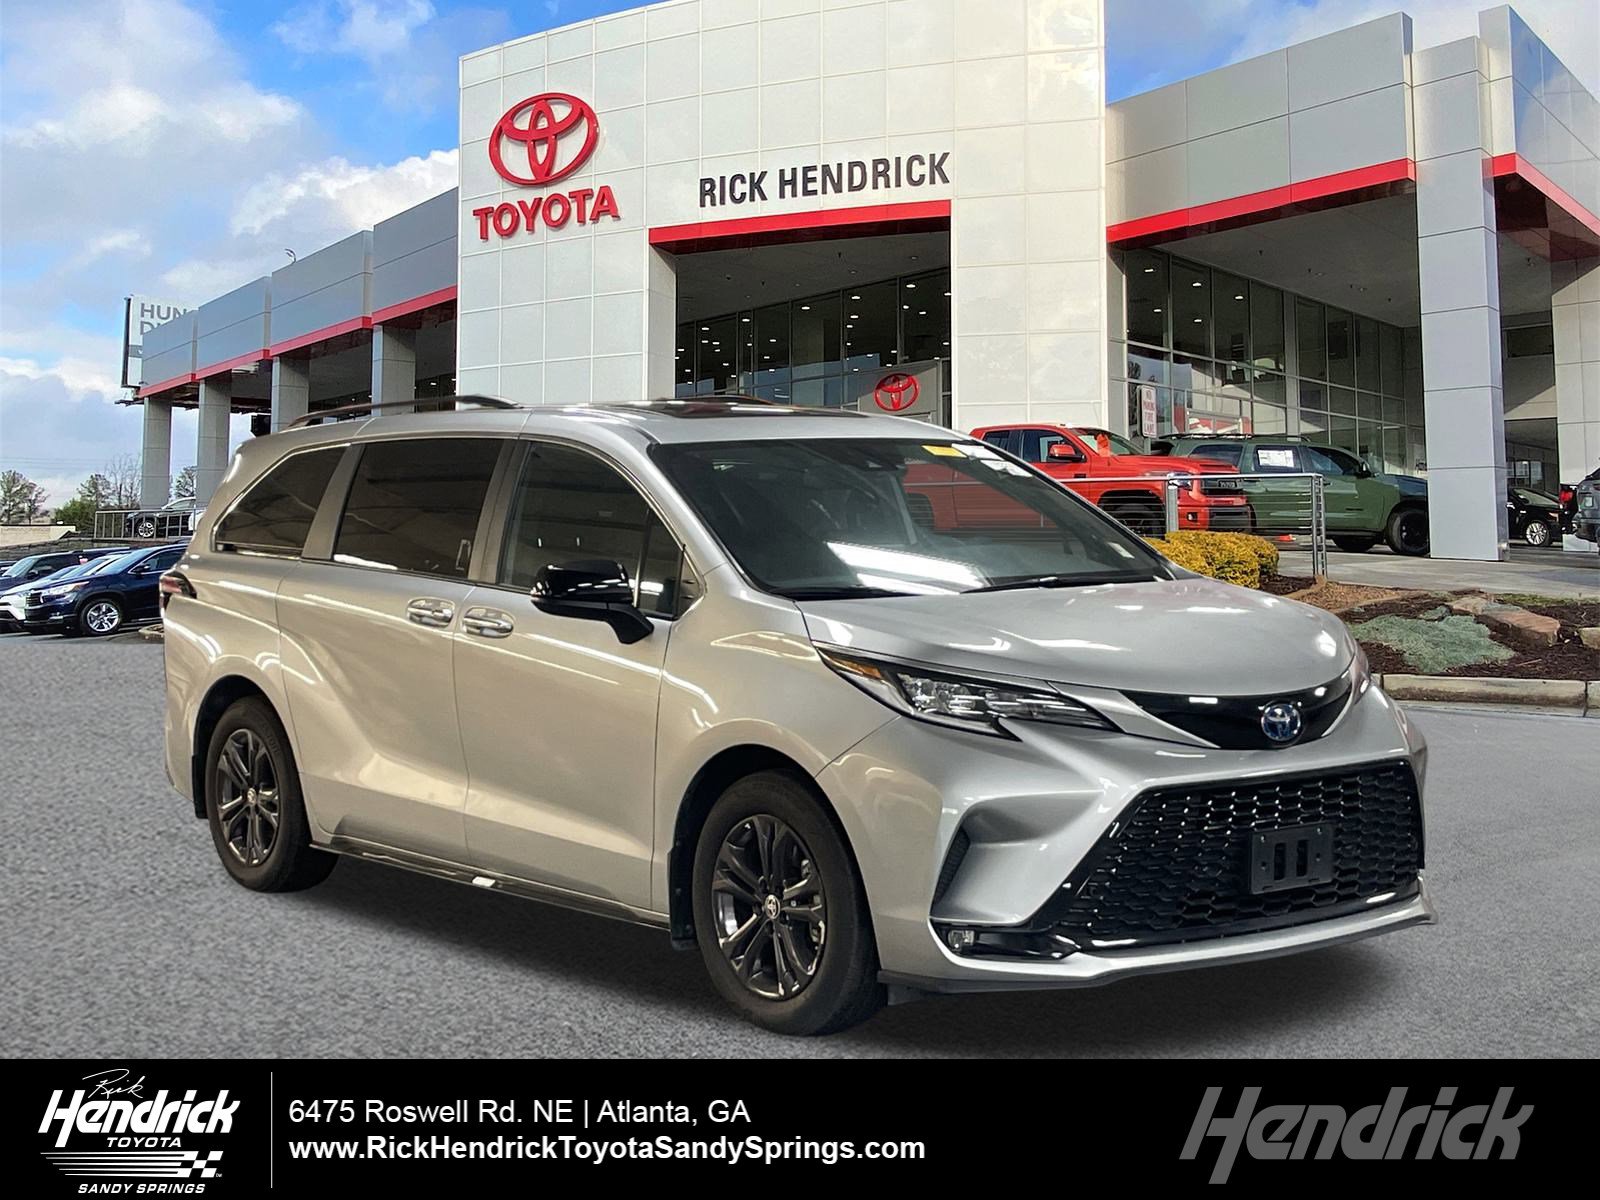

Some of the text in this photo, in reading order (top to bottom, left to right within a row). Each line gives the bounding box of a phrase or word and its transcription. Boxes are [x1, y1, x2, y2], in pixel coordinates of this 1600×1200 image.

[699, 152, 951, 208] RICK HENDRICK
[473, 185, 620, 241] TOYOTA
